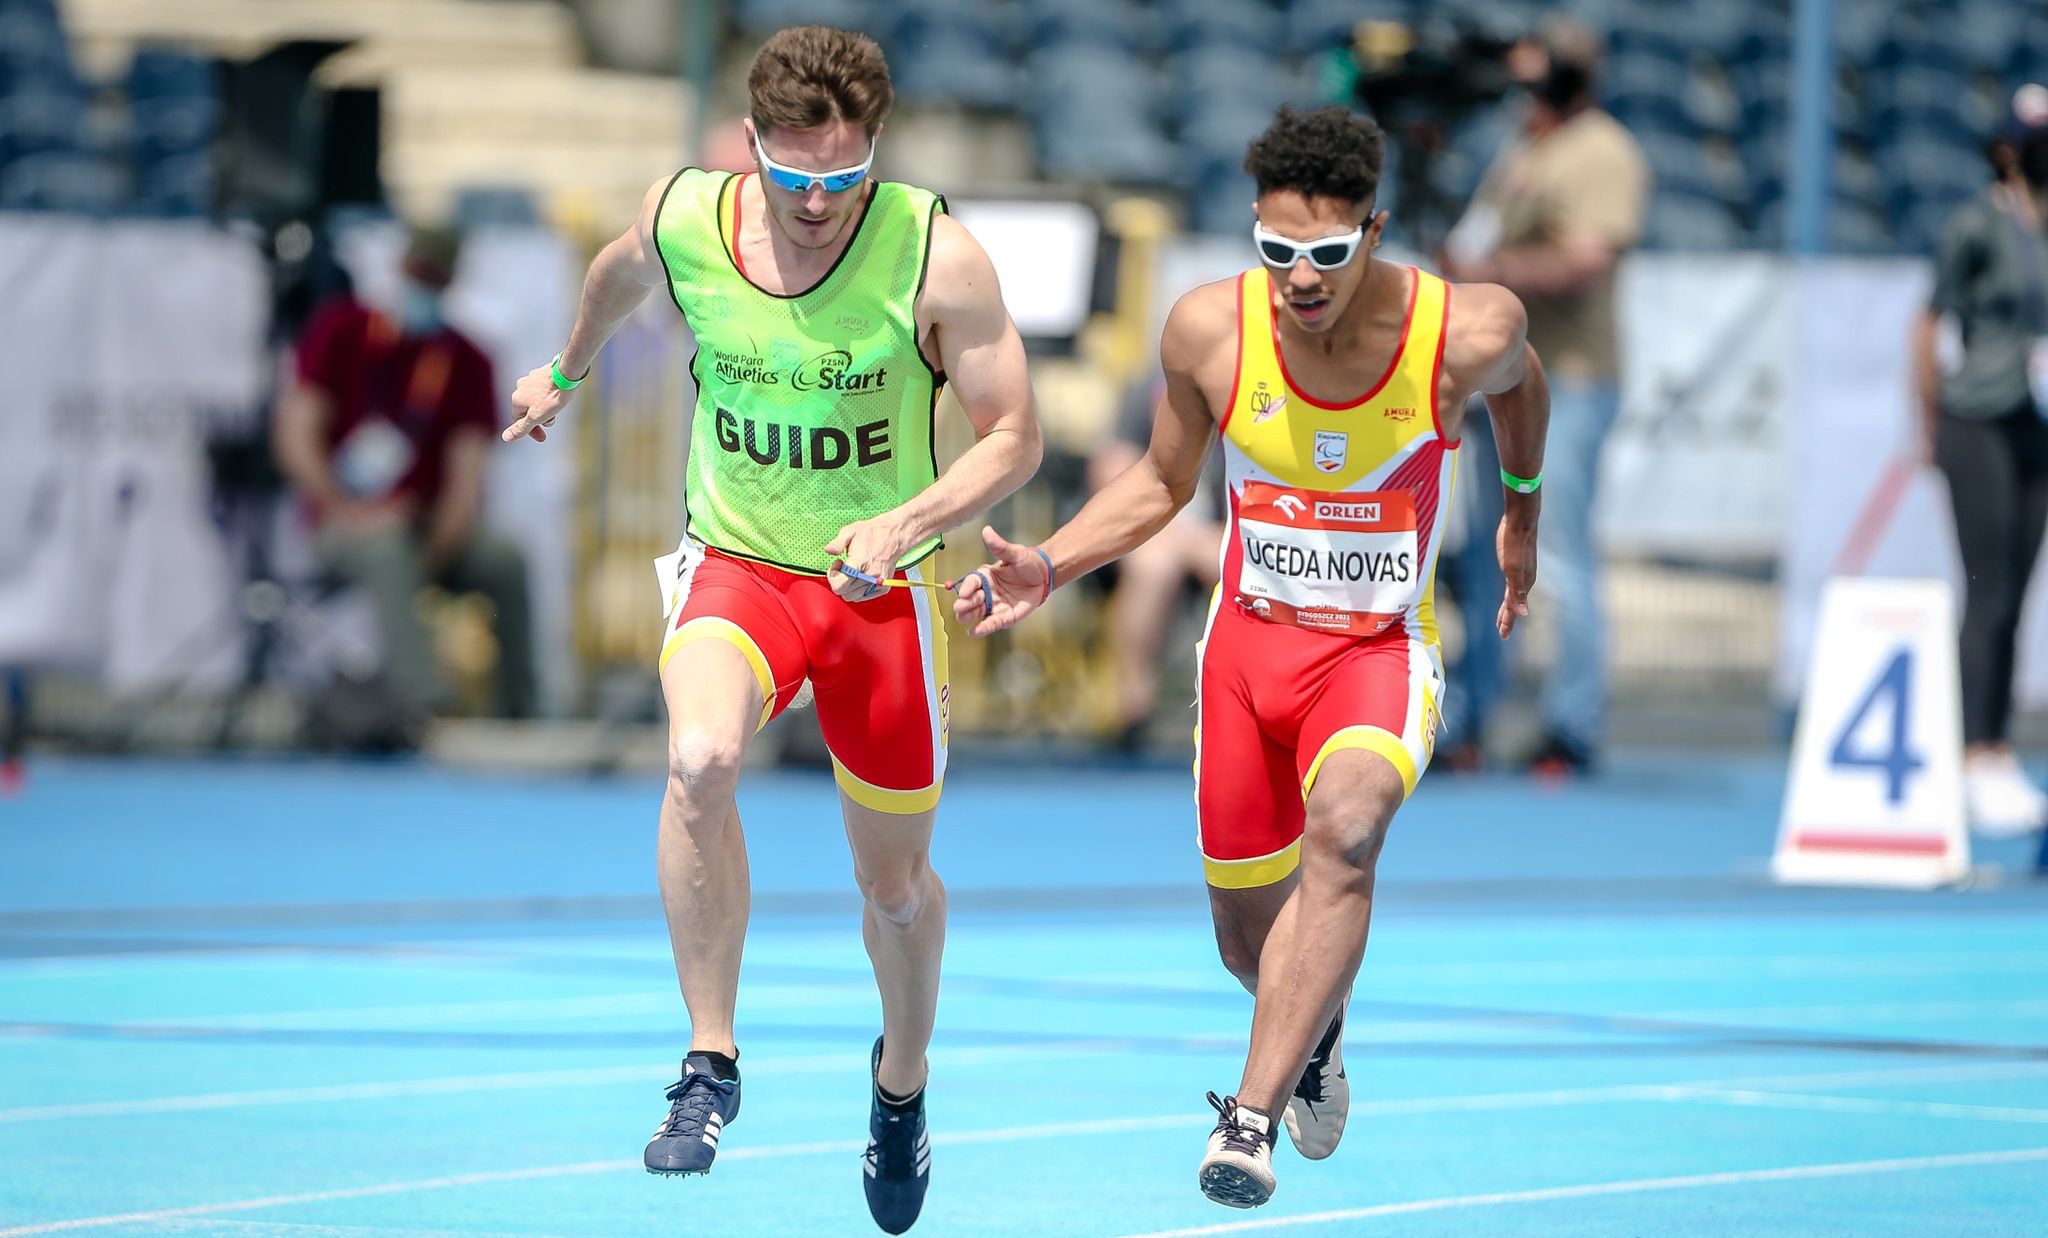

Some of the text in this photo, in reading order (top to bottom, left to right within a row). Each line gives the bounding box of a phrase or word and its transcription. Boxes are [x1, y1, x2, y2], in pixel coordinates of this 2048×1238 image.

[714, 350, 763, 366] World Para
[821, 358, 844, 366] PZSN
[716, 361, 779, 385] Athletics
[818, 367, 887, 390] Start
[1251, 391, 1271, 413] CSD
[1384, 408, 1416, 417] AMURA
[715, 407, 892, 470] GUIDE
[1319, 505, 1376, 519] ORLEN
[1247, 537, 1409, 582] UCEDA NOVAS
[1829, 648, 1924, 802] 4
